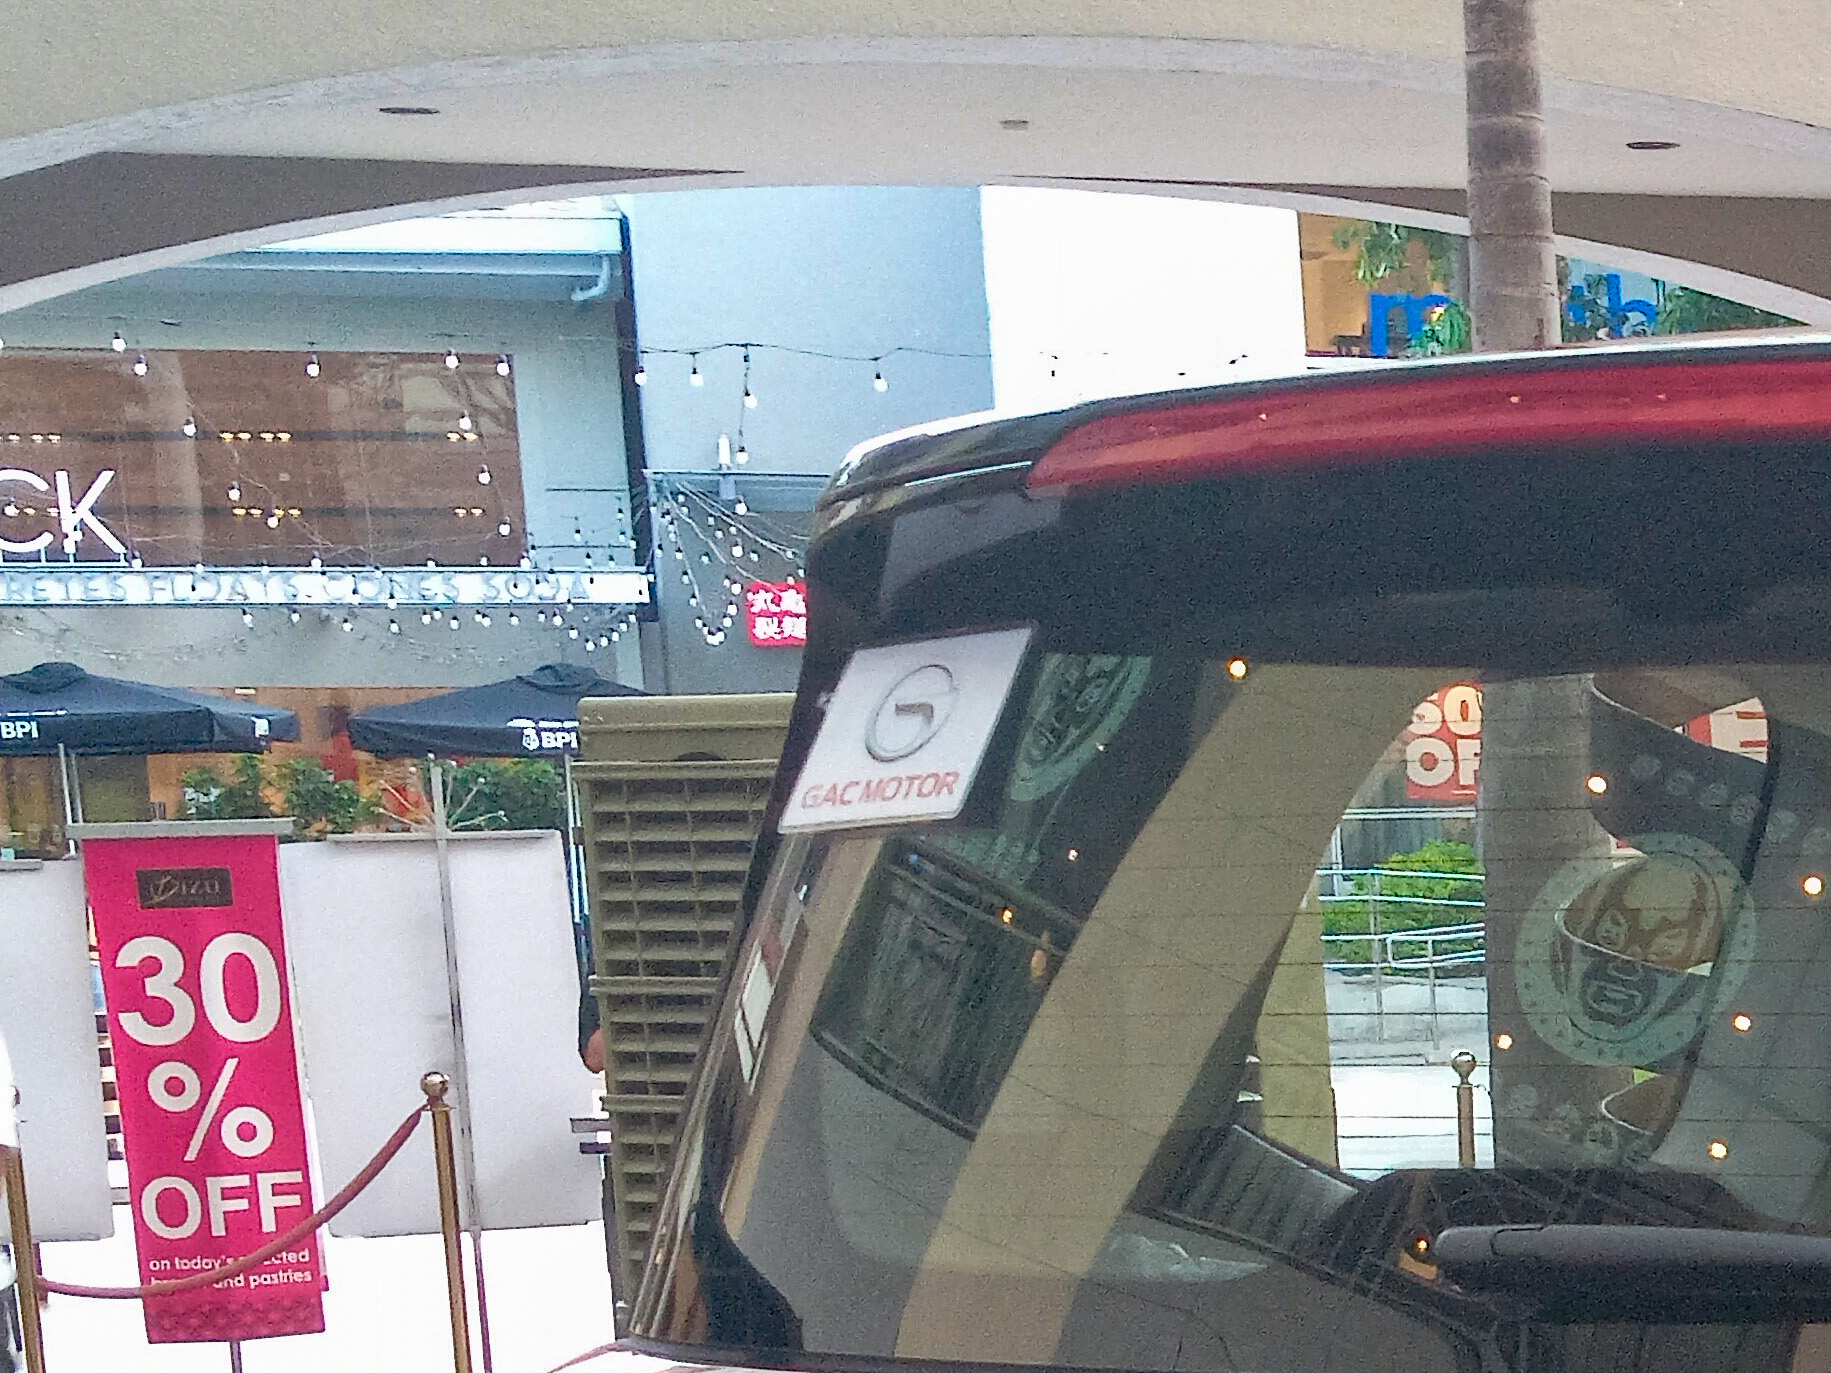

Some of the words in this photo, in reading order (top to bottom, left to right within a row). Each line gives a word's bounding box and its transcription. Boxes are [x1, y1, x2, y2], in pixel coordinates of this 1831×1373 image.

[0, 720, 39, 739] BPI
[541, 731, 578, 748] BPI
[802, 780, 859, 808] GAC
[859, 769, 961, 803] MOTOR
[115, 931, 282, 1045] 30
[147, 1056, 275, 1162] %
[141, 1170, 304, 1240] OFF
[149, 1258, 170, 1271] on
[249, 1268, 312, 1290] pastries
